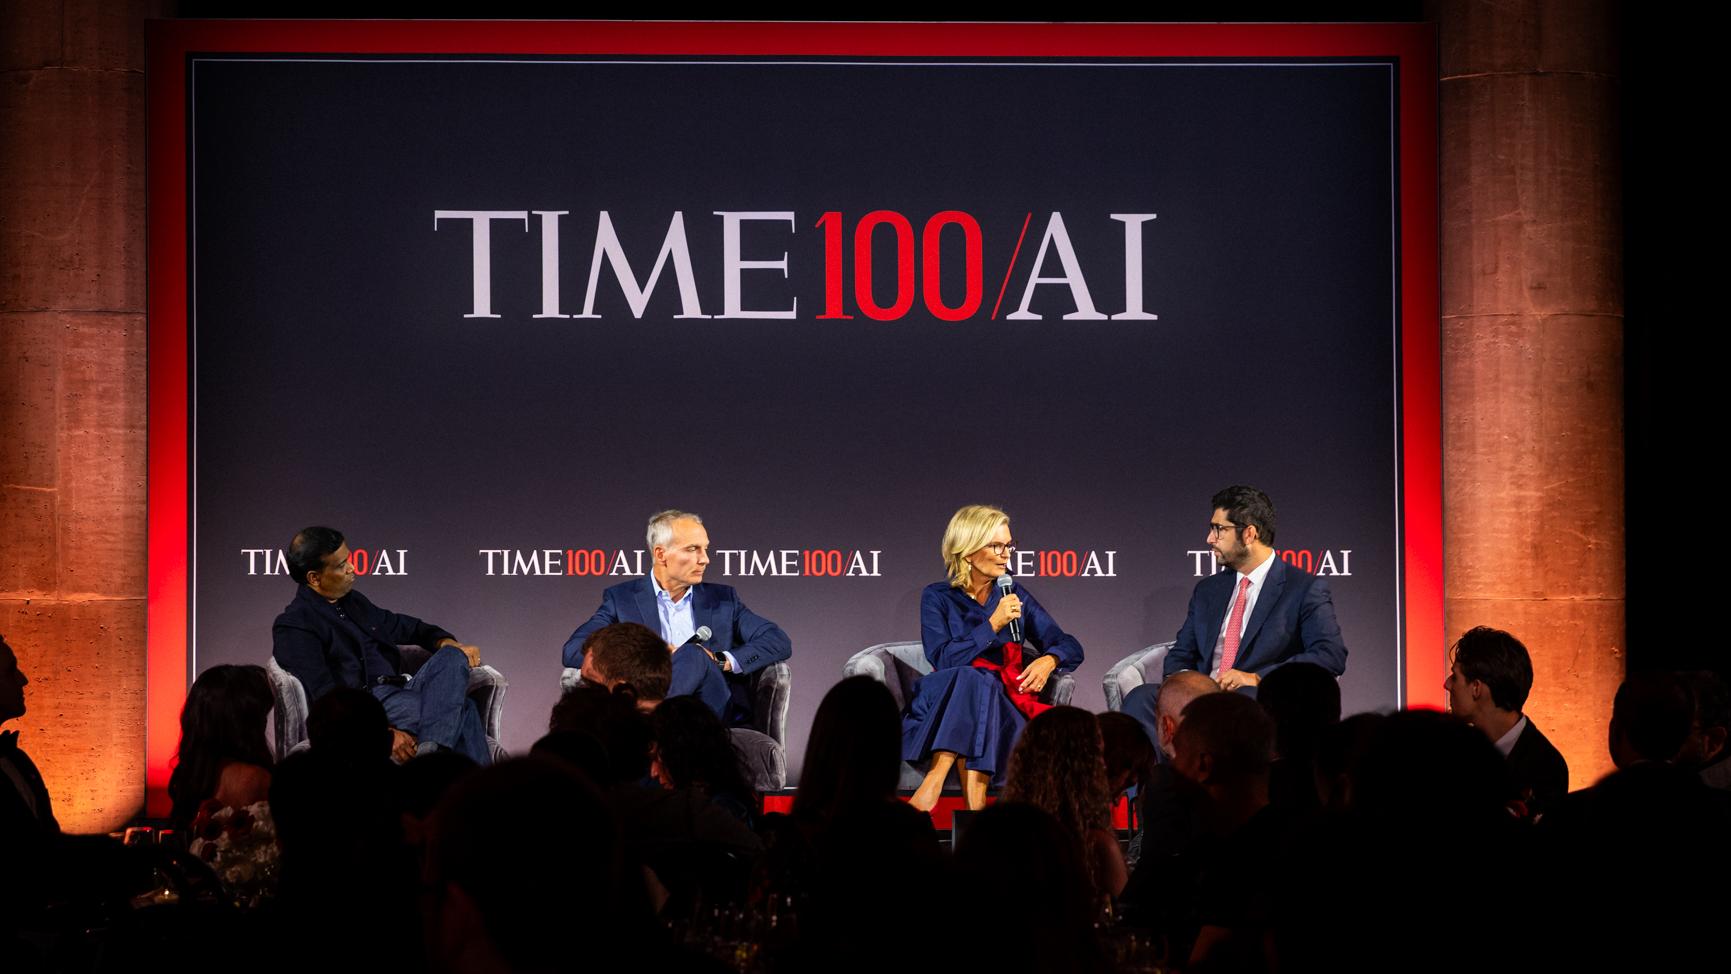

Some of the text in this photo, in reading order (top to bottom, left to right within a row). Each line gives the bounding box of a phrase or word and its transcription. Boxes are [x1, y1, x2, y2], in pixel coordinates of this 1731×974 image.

[434, 210, 797, 320] TIME
[479, 549, 563, 576] TIME
[716, 549, 799, 576] TIME
